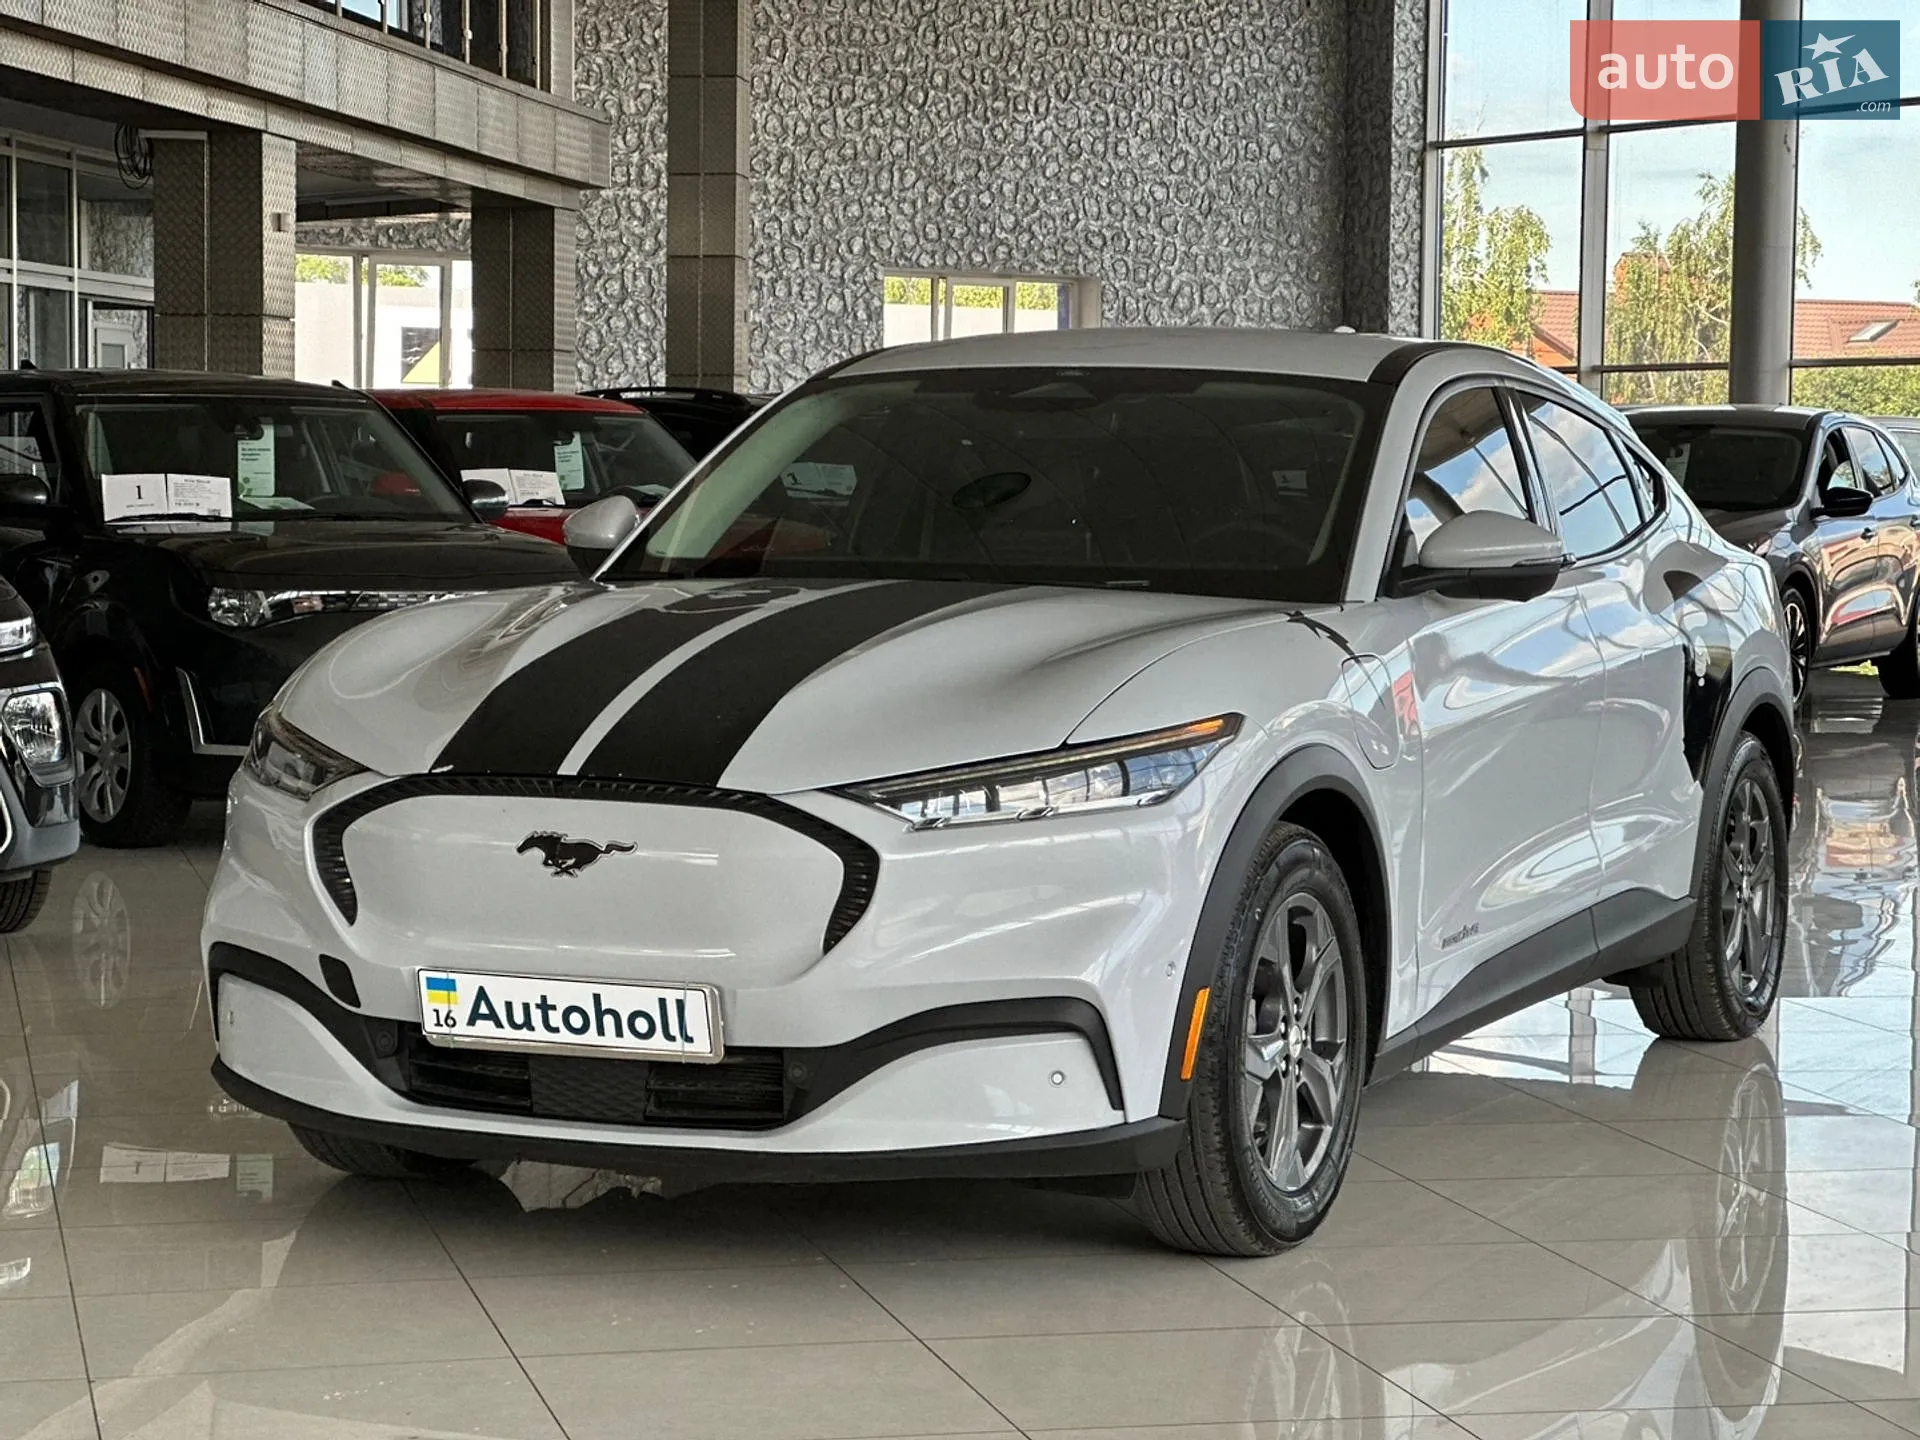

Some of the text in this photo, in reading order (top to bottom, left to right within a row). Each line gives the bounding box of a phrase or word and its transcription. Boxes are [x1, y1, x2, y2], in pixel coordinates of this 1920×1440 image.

[135, 485, 144, 500] 1
[432, 985, 695, 1044] 16 Autoholl
